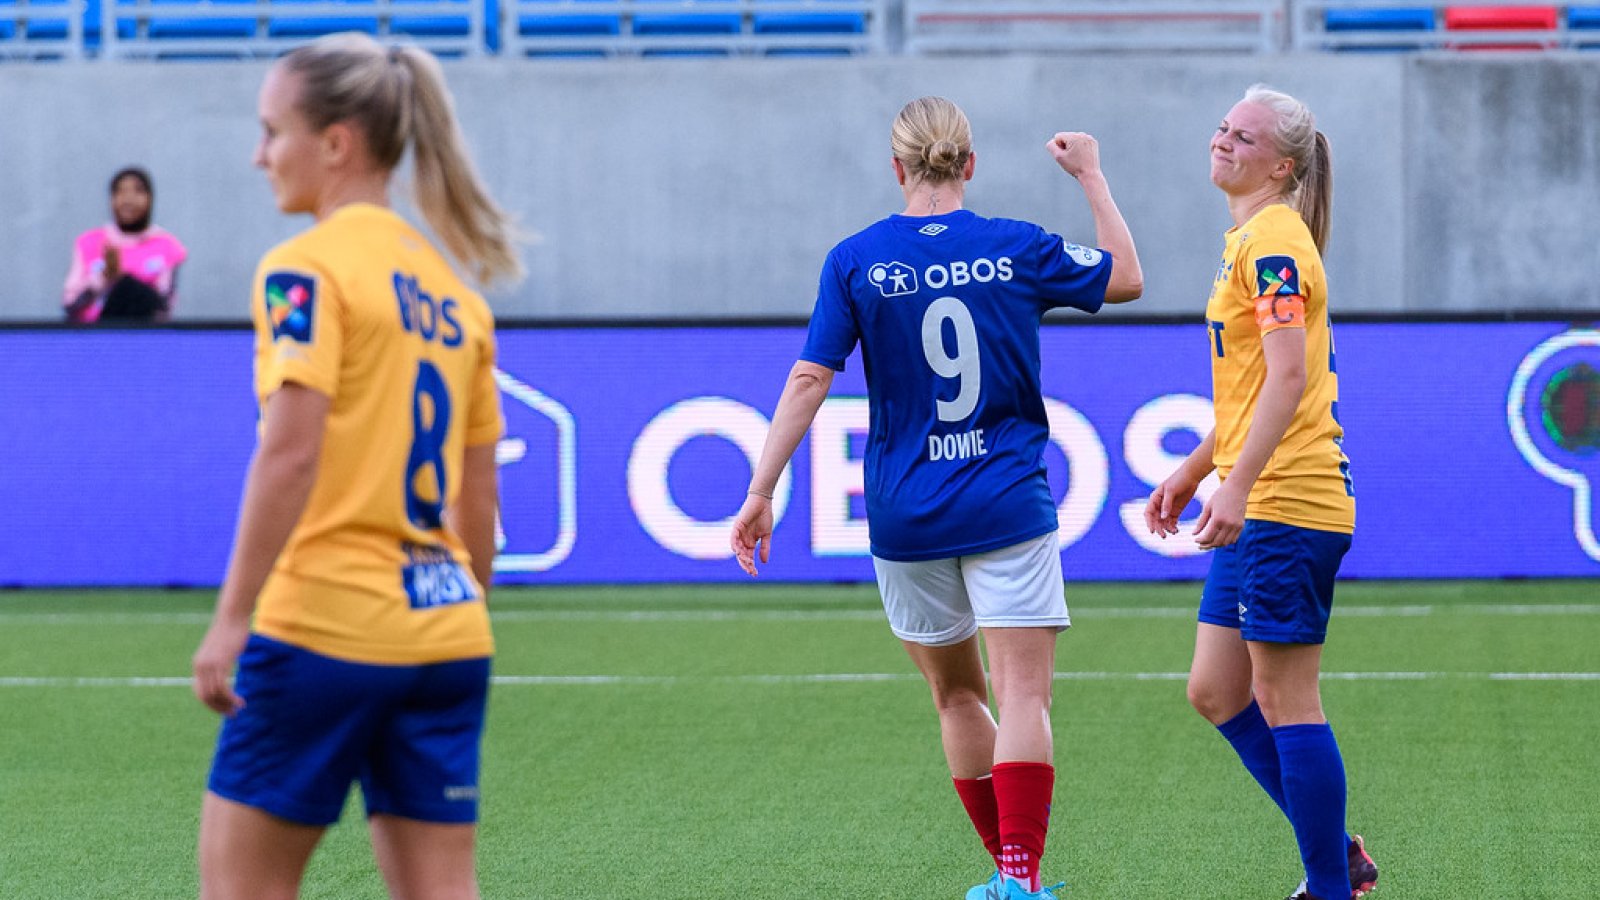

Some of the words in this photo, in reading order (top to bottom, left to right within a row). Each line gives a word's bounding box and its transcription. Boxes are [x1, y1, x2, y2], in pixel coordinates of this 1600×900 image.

[924, 256, 1014, 289] OBOS
[1271, 295, 1295, 324] C
[921, 297, 980, 423] 9
[405, 359, 451, 529] 8
[928, 429, 988, 461] DOWIE
